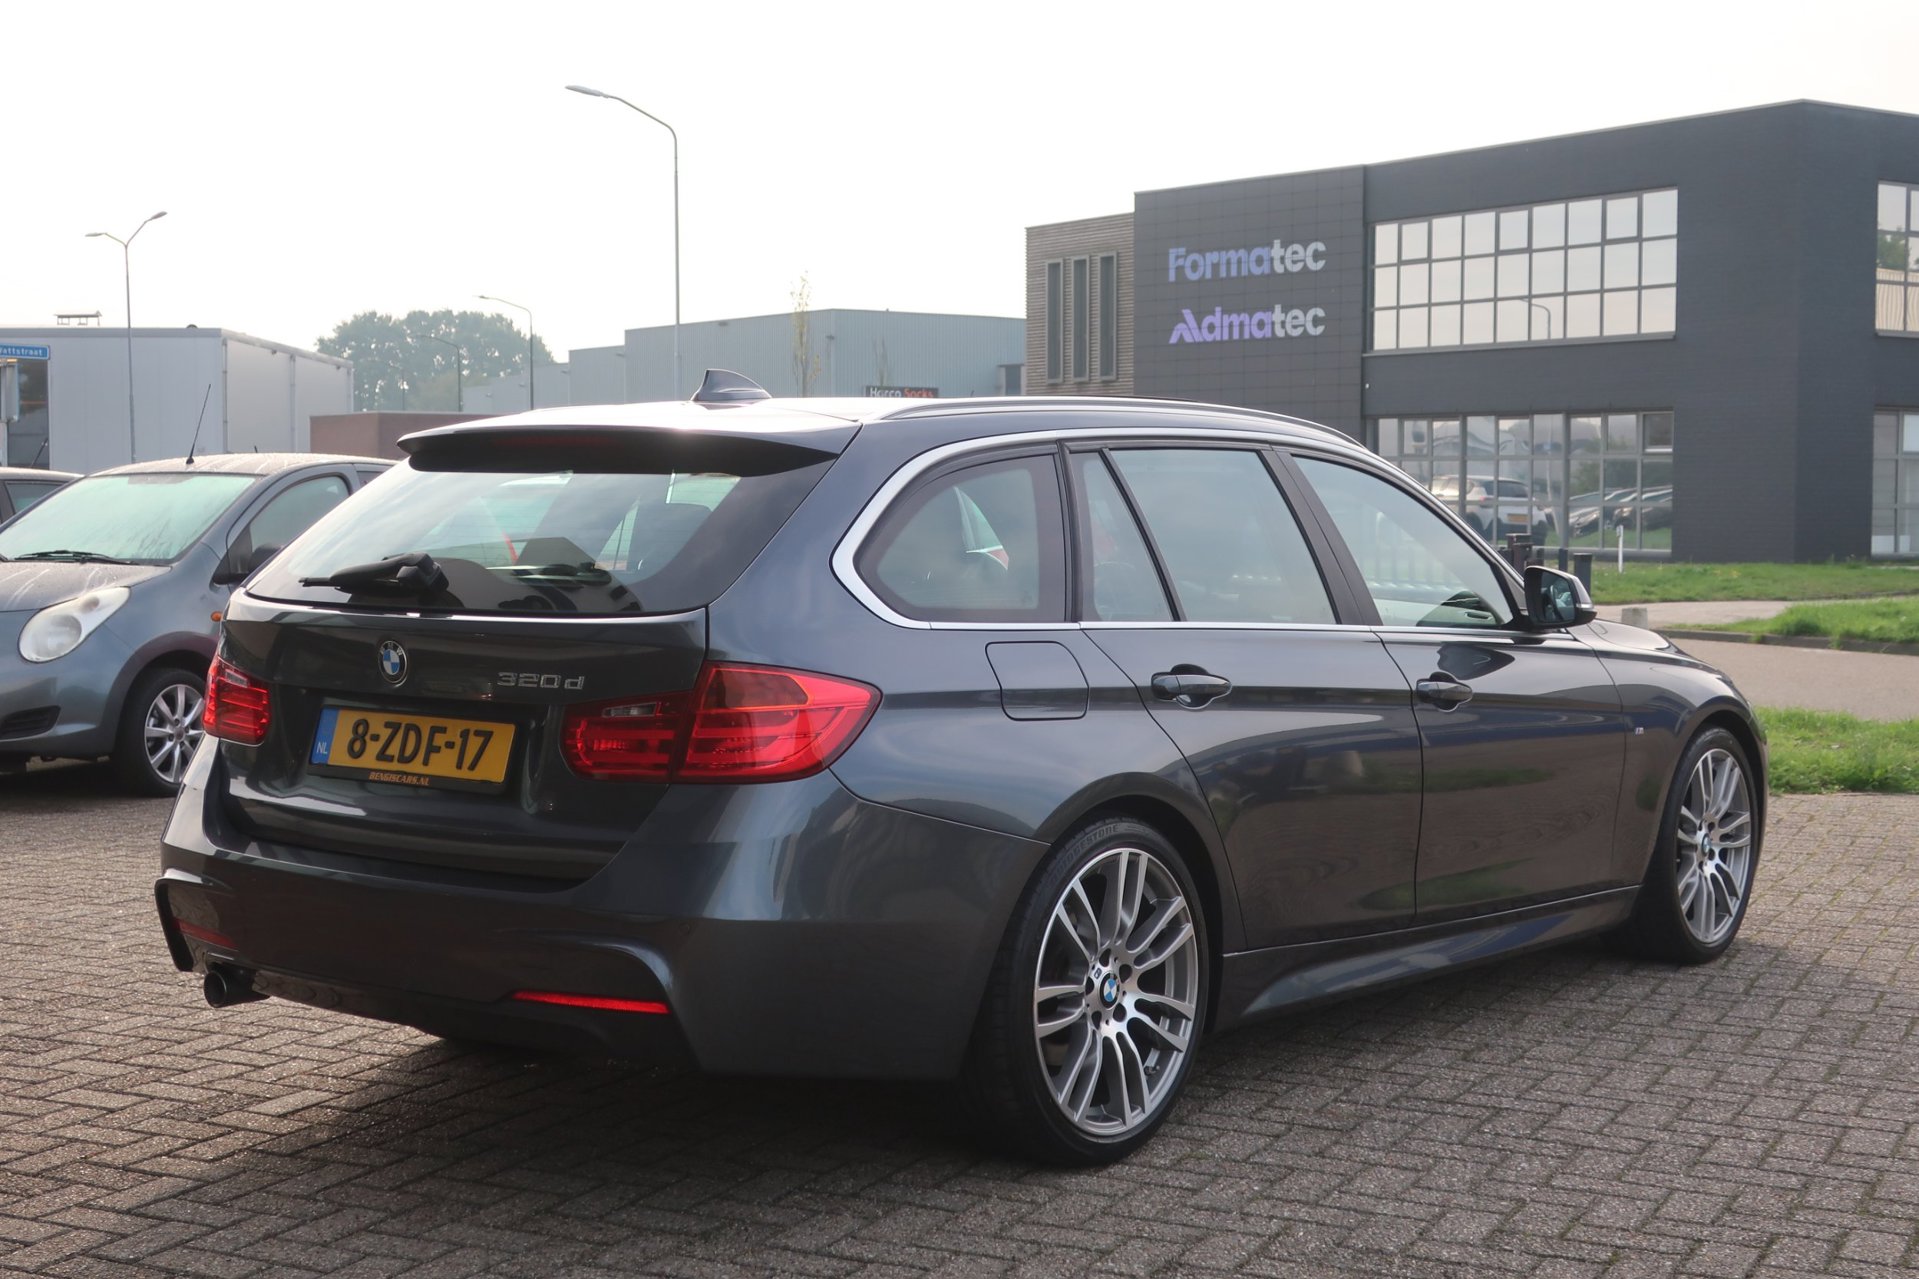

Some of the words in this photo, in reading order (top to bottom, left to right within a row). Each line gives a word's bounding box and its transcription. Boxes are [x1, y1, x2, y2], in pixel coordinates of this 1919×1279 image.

[1168, 239, 1327, 282] Formatec
[1168, 304, 1326, 344] Admatec
[904, 388, 934, 398] Socks
[316, 741, 328, 754] NL
[347, 718, 494, 772] 8-ZDF-17
